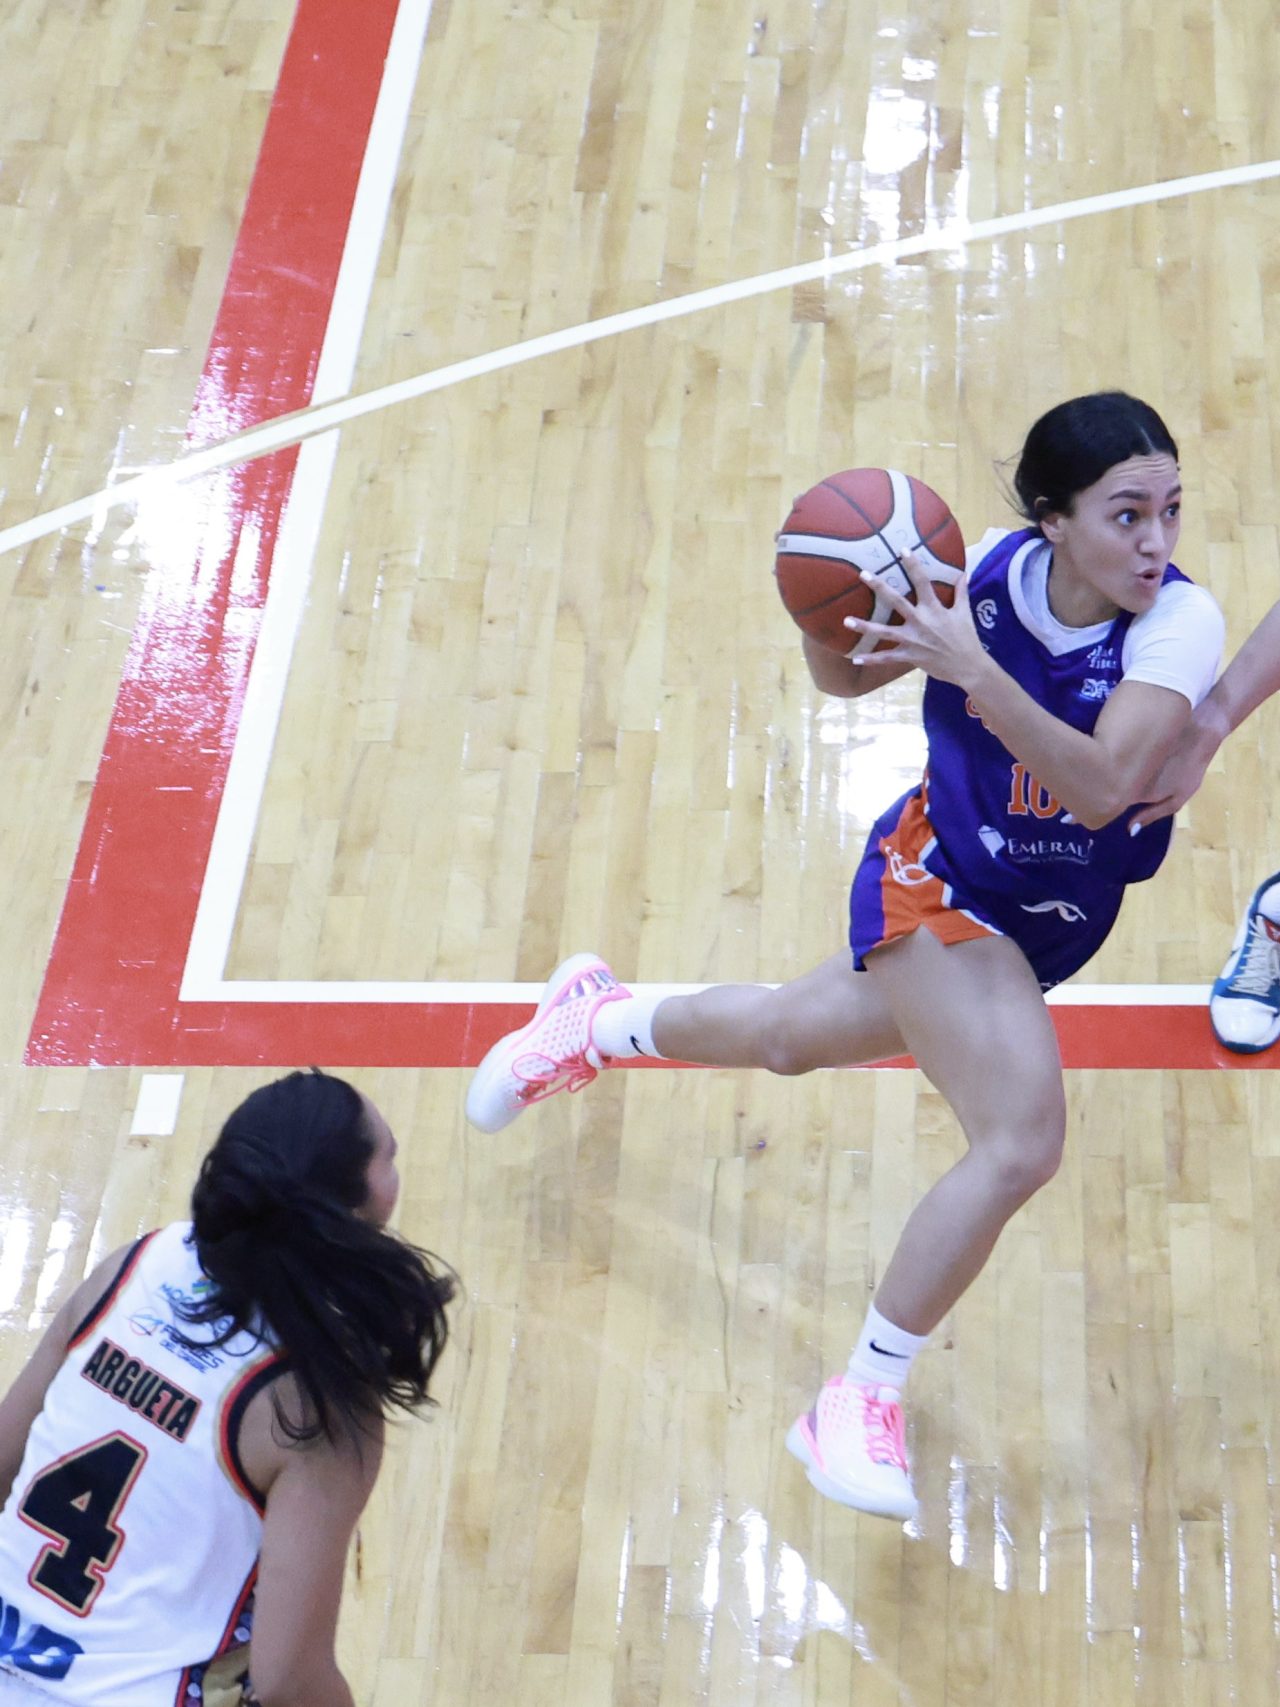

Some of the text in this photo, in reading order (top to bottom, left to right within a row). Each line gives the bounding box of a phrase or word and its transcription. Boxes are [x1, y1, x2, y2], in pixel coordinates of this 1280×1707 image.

[1007, 763, 1062, 819] 10
[1007, 838, 1094, 858] EMERAL
[80, 1337, 202, 1443] ARGUETA
[18, 1430, 148, 1618] 4
